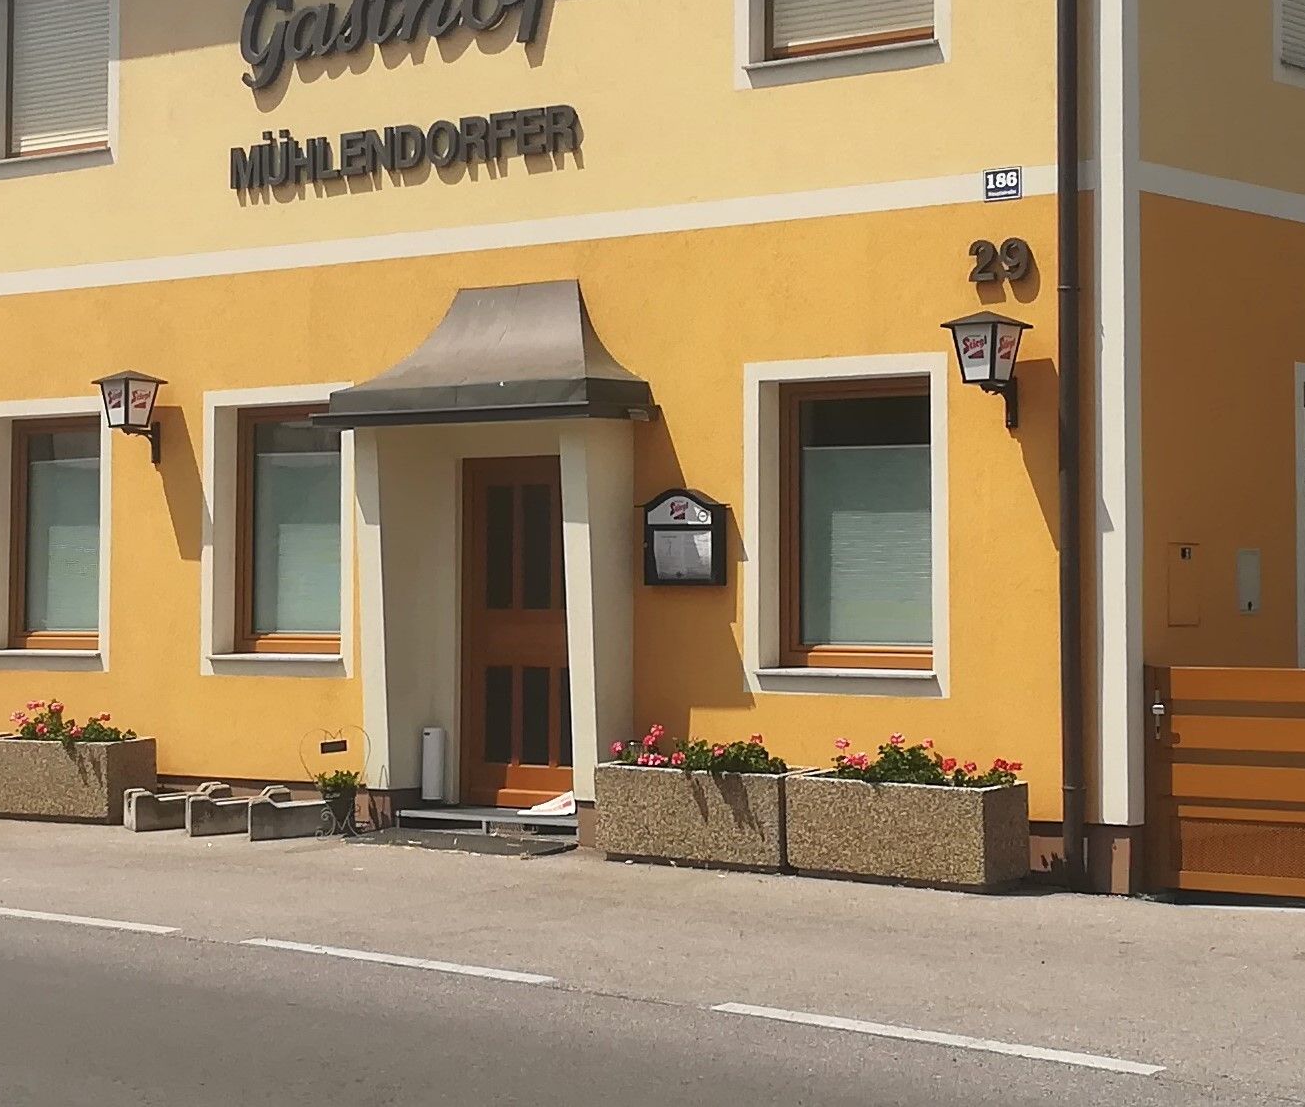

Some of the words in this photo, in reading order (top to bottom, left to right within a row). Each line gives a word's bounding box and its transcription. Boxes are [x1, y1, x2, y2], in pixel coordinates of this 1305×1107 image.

[230, 104, 583, 189] MÜHLENDORFER
[986, 171, 1018, 189] 186
[968, 237, 1029, 283] 29
